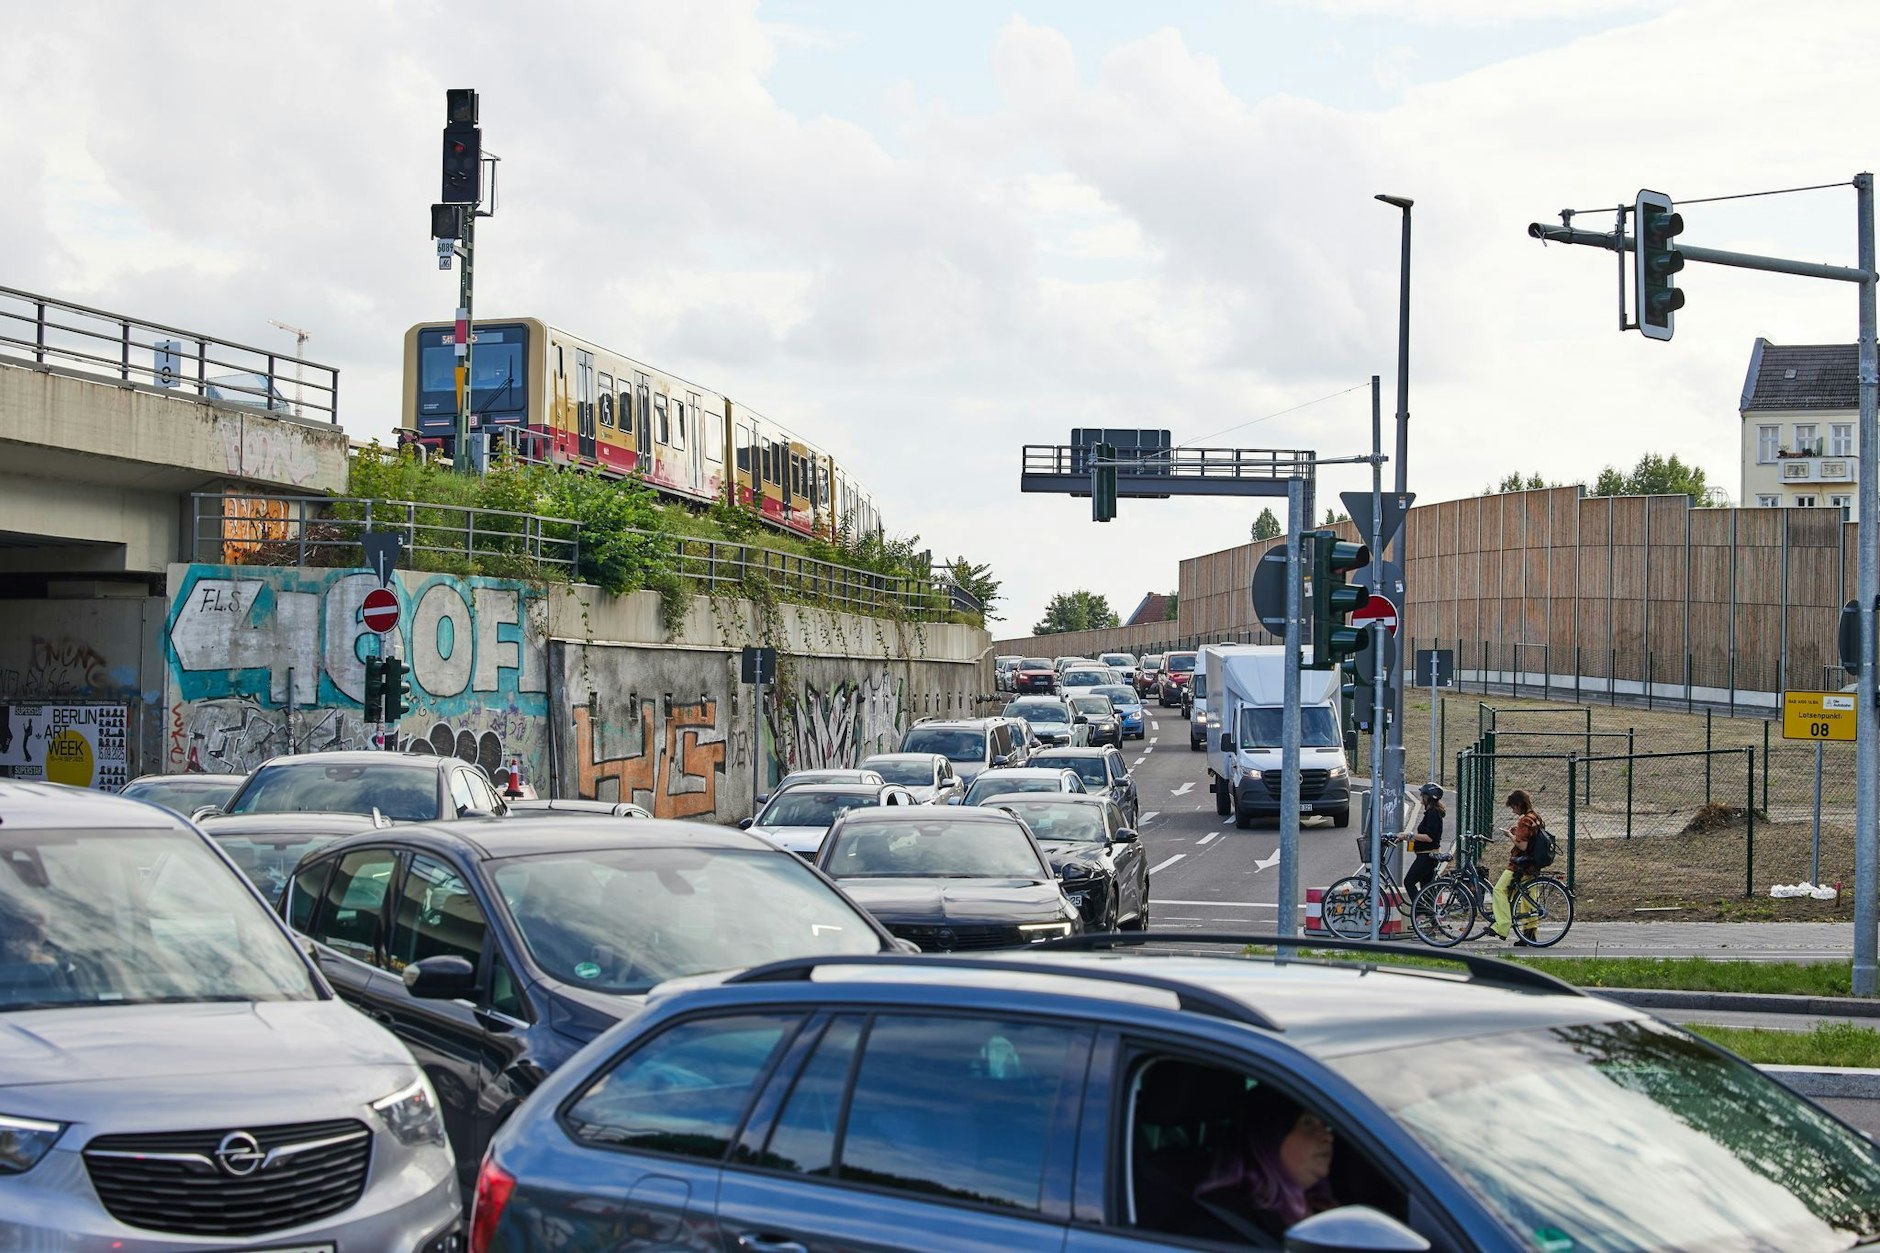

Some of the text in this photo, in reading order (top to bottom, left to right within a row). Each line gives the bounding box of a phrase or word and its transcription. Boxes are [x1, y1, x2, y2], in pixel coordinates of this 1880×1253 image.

[437, 243, 454, 253] 6089
[200, 588, 242, 612] F.L.S.
[53, 708, 97, 725] BERLIN
[44, 725, 70, 740] ART
[1811, 722, 1829, 737] 08
[47, 740, 84, 756] WEEK
